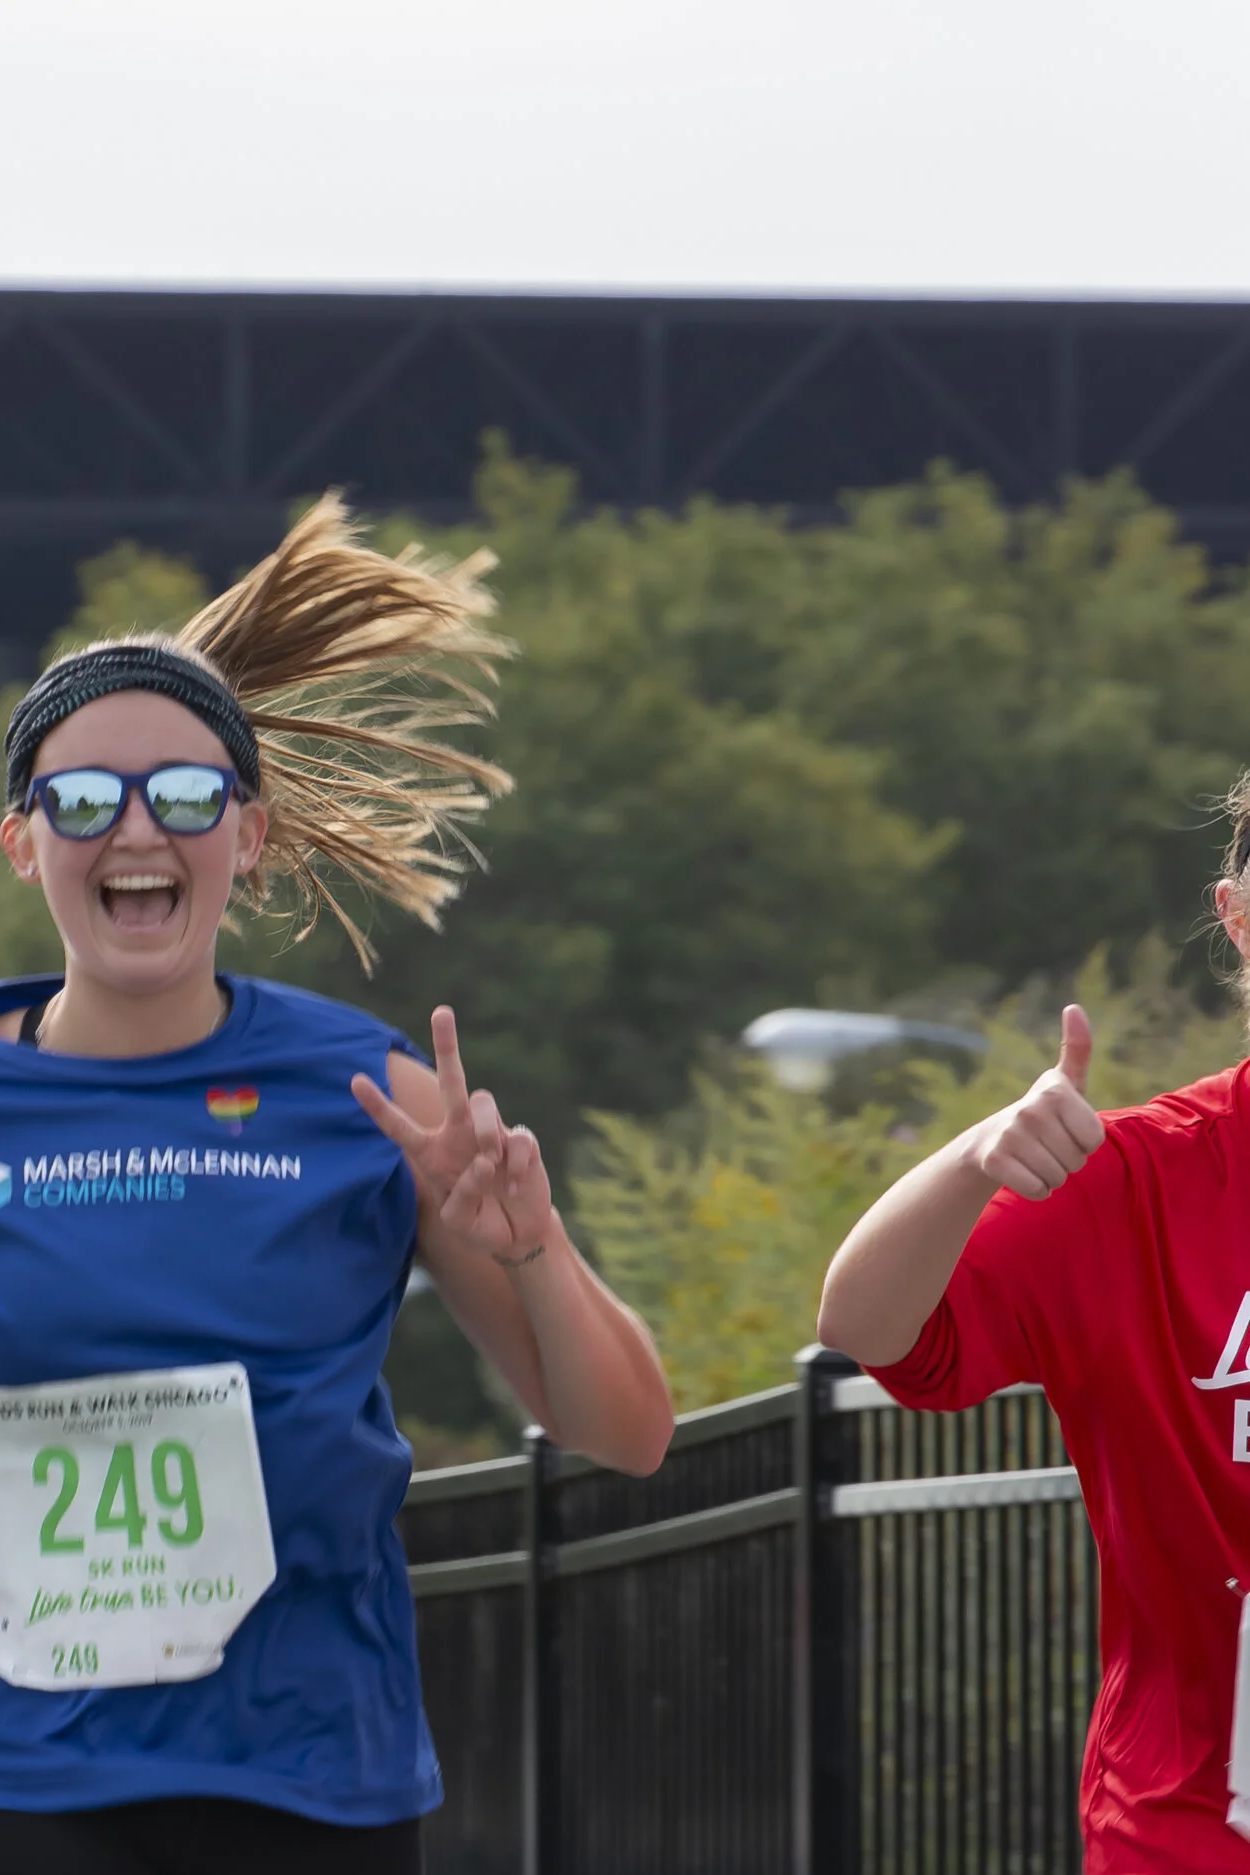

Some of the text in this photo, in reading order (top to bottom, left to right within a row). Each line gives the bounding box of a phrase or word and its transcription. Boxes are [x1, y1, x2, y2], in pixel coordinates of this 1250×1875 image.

[23, 1148, 121, 1184] MARSH
[126, 1147, 145, 1176] &
[23, 1173, 186, 1208] COMPANIES
[27, 1400, 63, 1420] RUN
[86, 1391, 138, 1415] WALK
[144, 1384, 228, 1409] CHICAGO
[32, 1437, 204, 1556] 249
[122, 1553, 165, 1577] RUN
[140, 1581, 167, 1608] BE
[52, 1642, 98, 1677] 249
